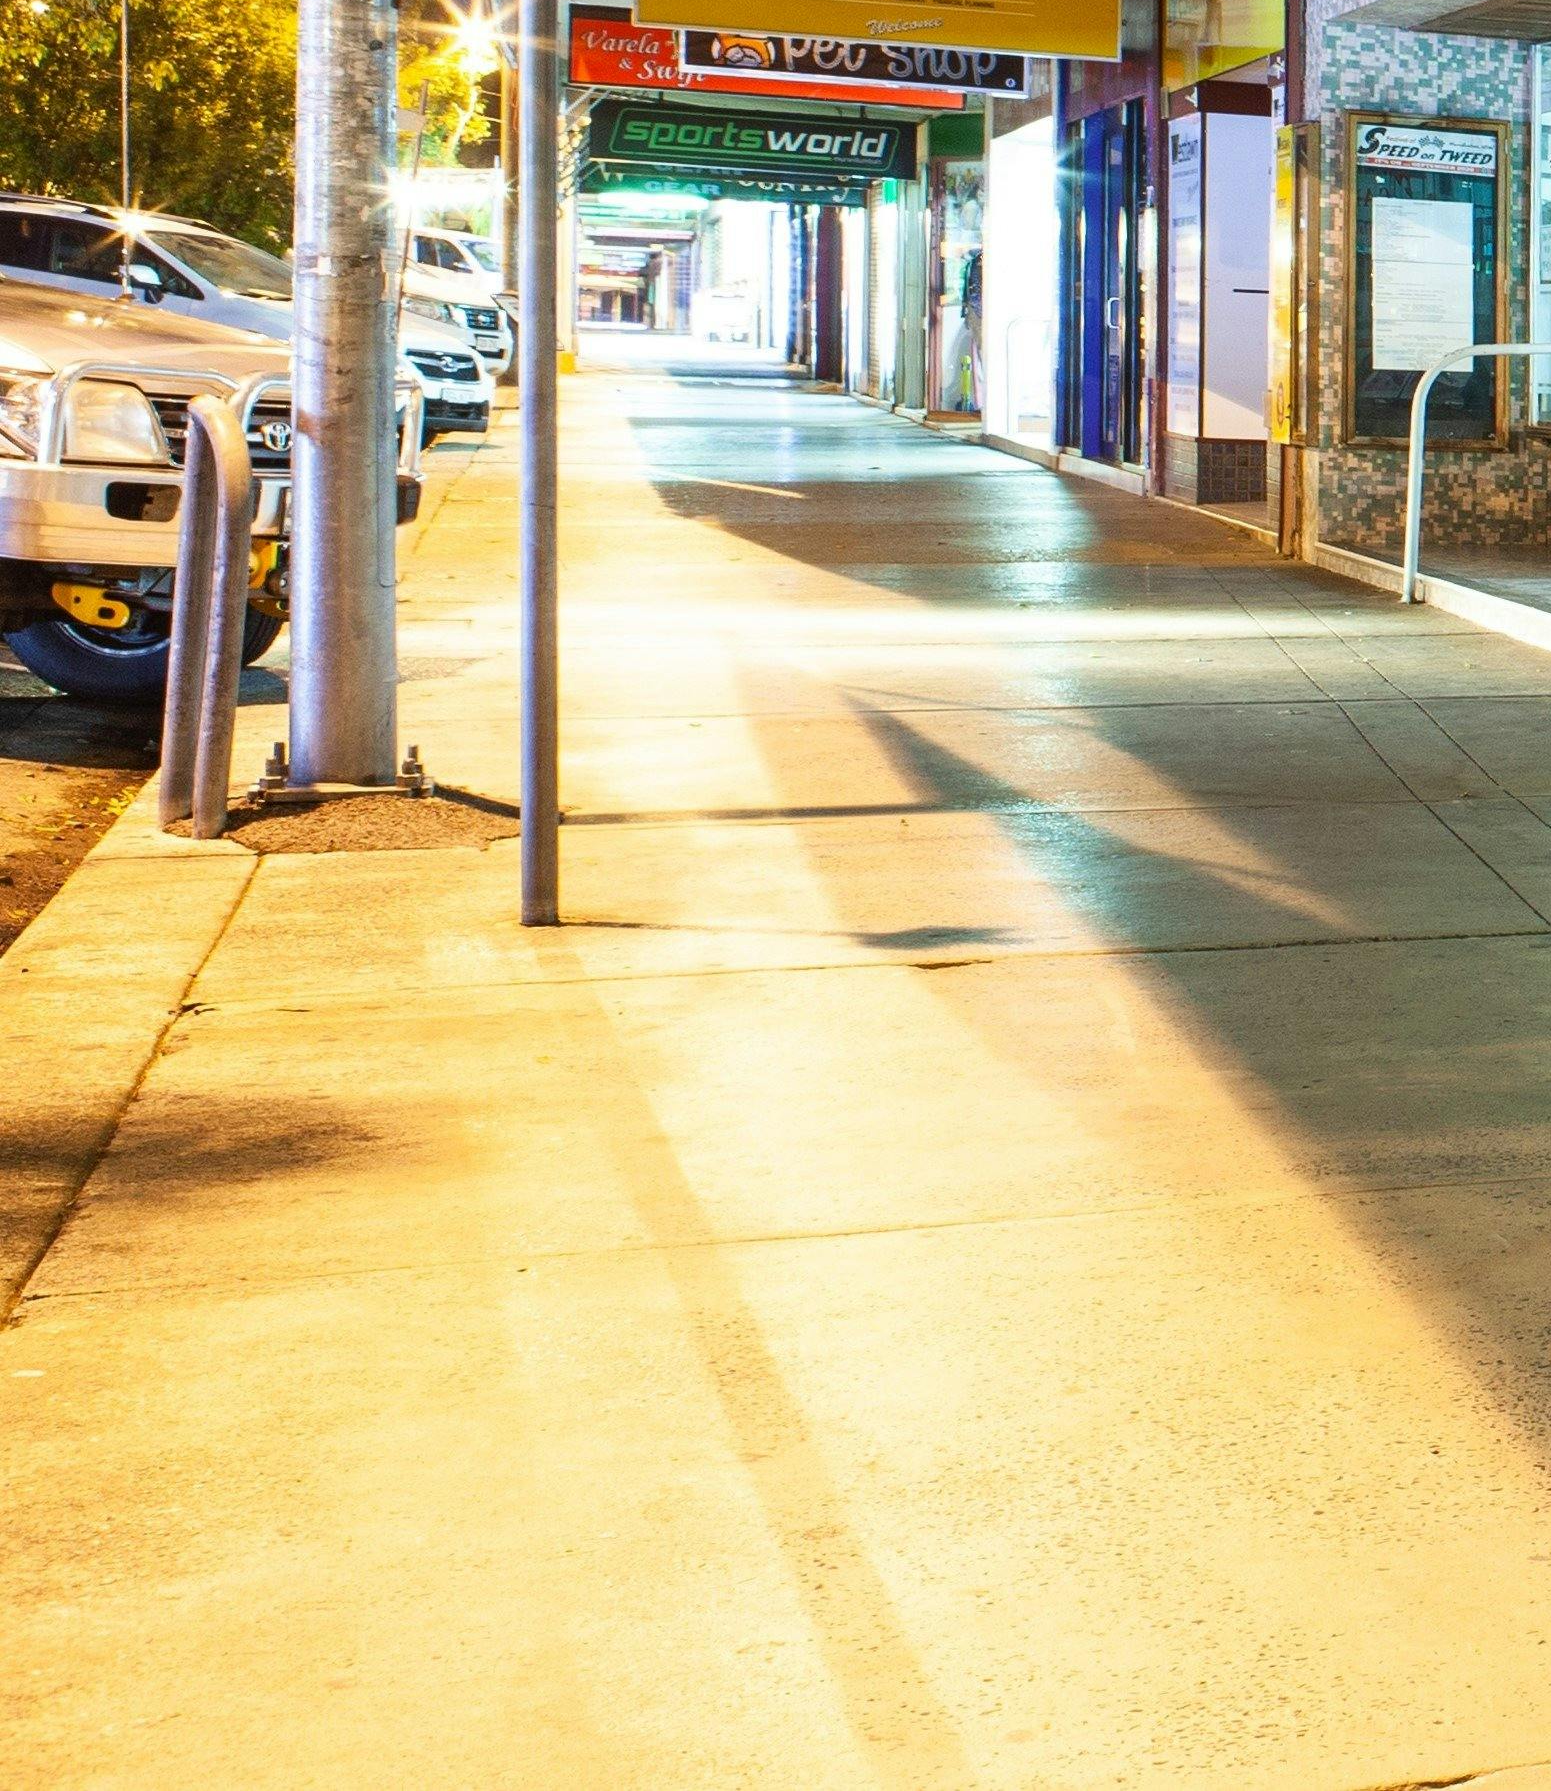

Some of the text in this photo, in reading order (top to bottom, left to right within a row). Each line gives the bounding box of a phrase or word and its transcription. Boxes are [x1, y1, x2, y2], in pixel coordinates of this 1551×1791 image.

[580, 28, 661, 55] Varela
[622, 118, 889, 160] sportsworld
[1357, 126, 1493, 166] SPEED on TWEED
